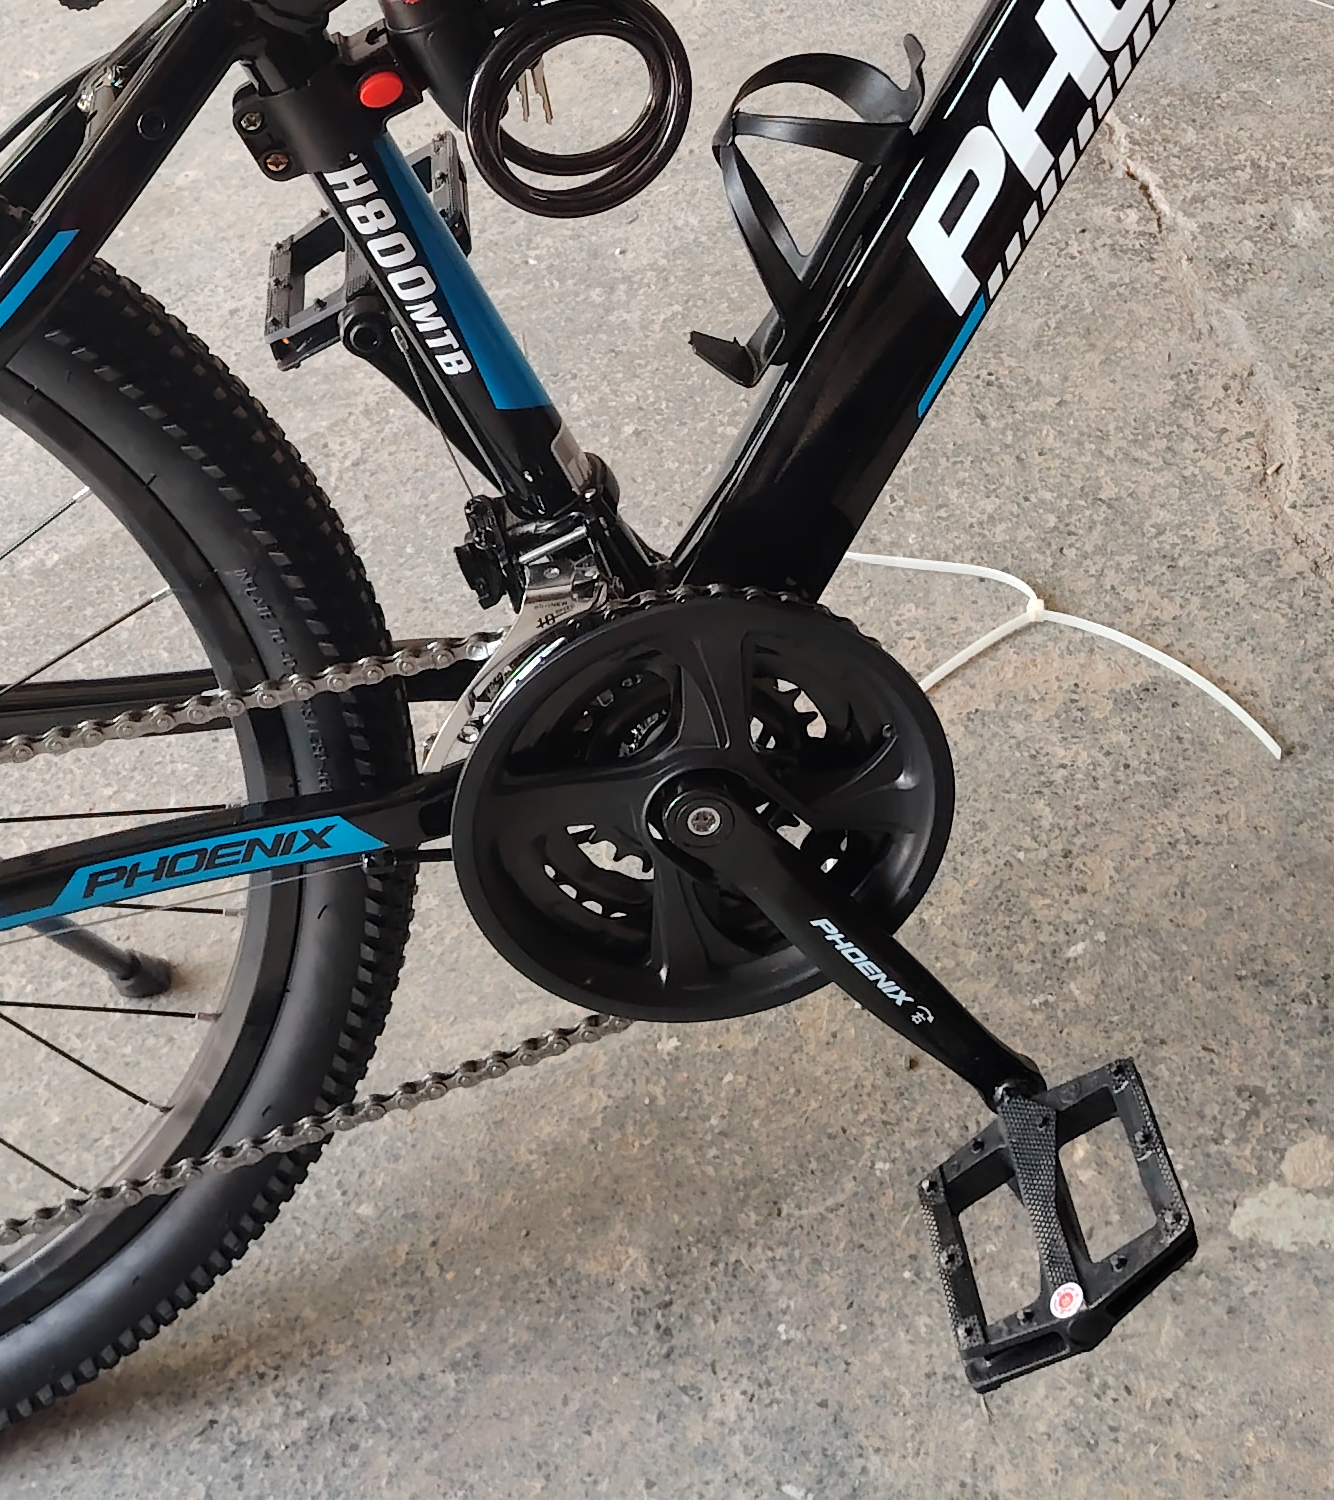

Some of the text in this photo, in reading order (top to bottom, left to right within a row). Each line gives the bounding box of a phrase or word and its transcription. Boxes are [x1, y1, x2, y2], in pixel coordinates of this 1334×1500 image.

[323, 152, 472, 376] H800MTB
[82, 824, 341, 898] PHOENIX
[809, 918, 915, 1007] PHOENIX
